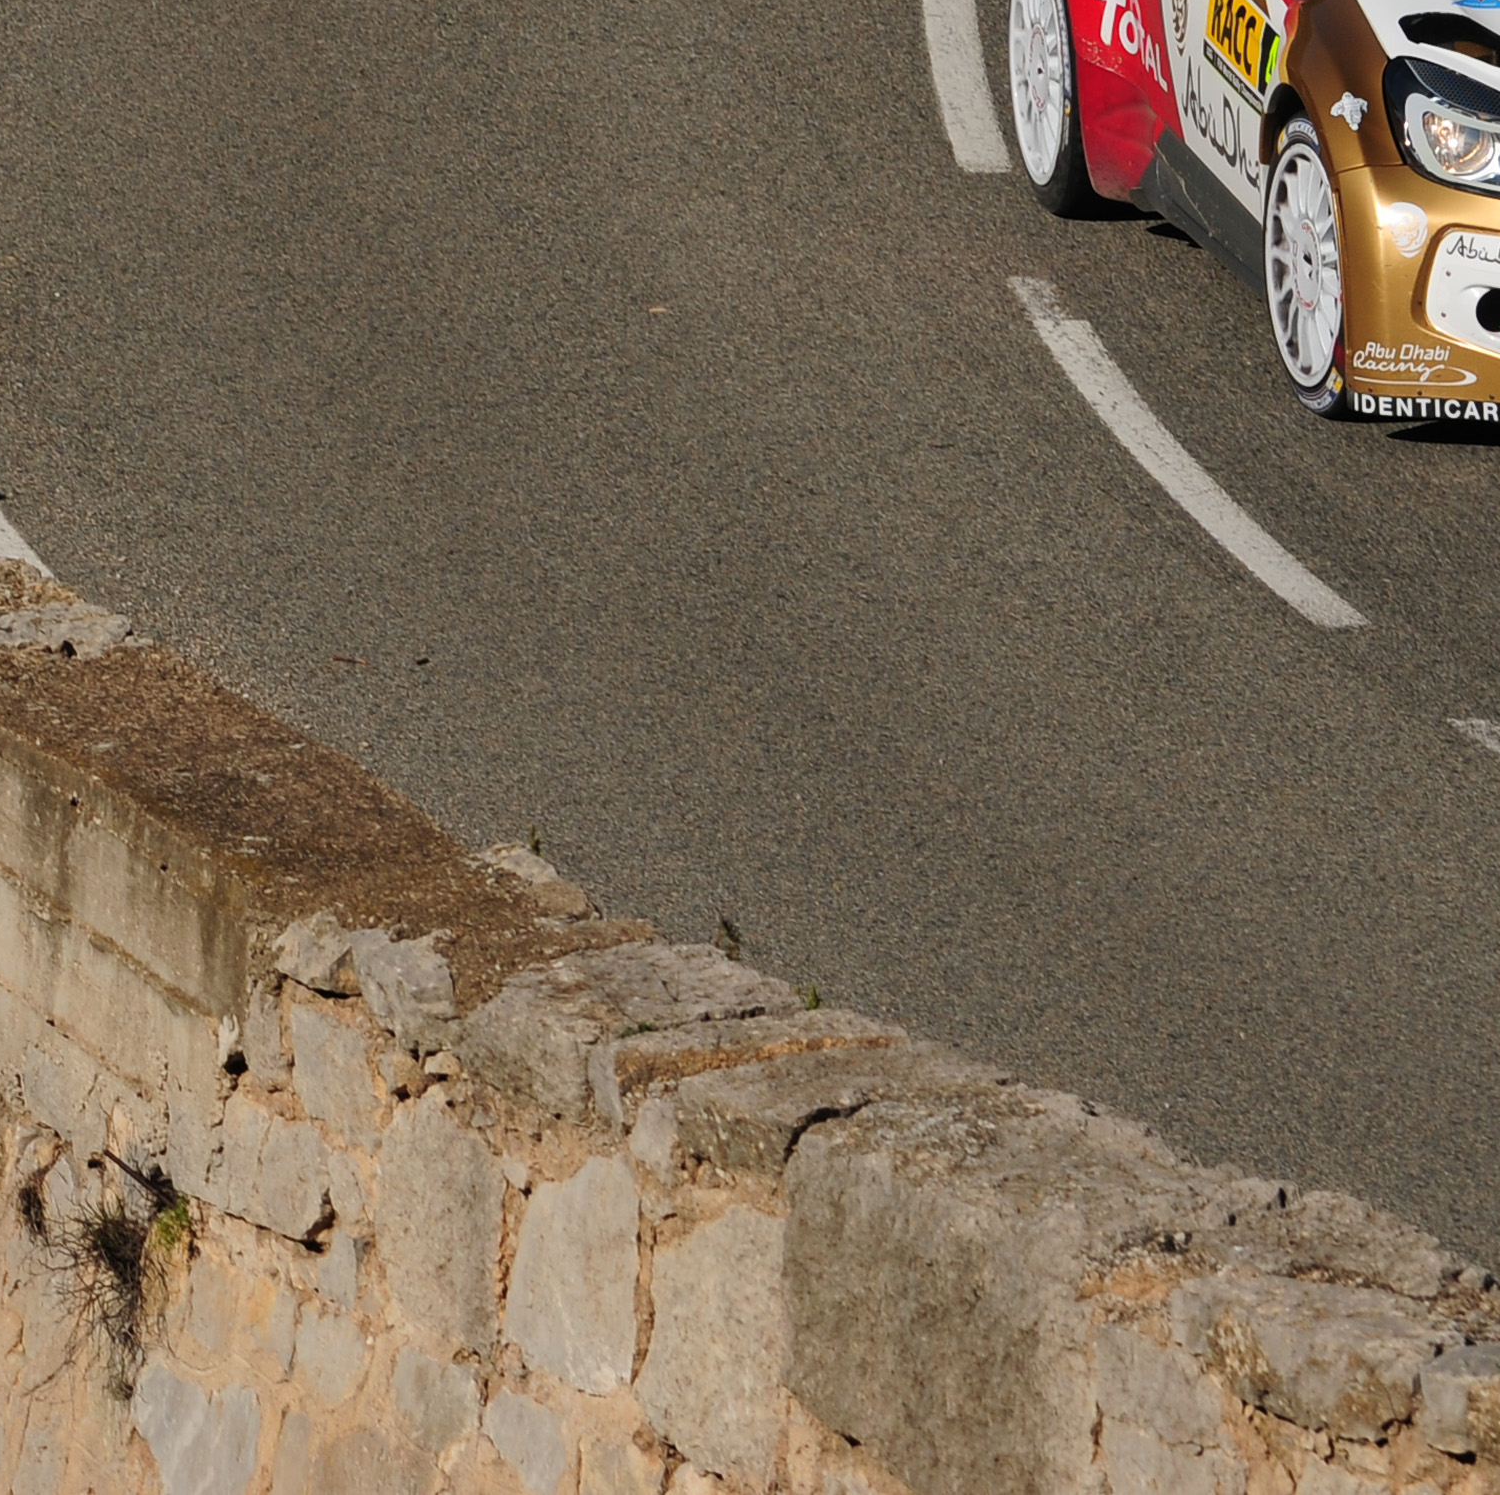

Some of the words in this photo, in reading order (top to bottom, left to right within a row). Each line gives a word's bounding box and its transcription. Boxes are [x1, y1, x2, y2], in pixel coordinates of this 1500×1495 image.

[1353, 350, 1445, 382] Racing
[1365, 341, 1396, 359] Abu
[1400, 344, 1450, 362] Dhabi
[1354, 392, 1499, 422] IDENTICAR
